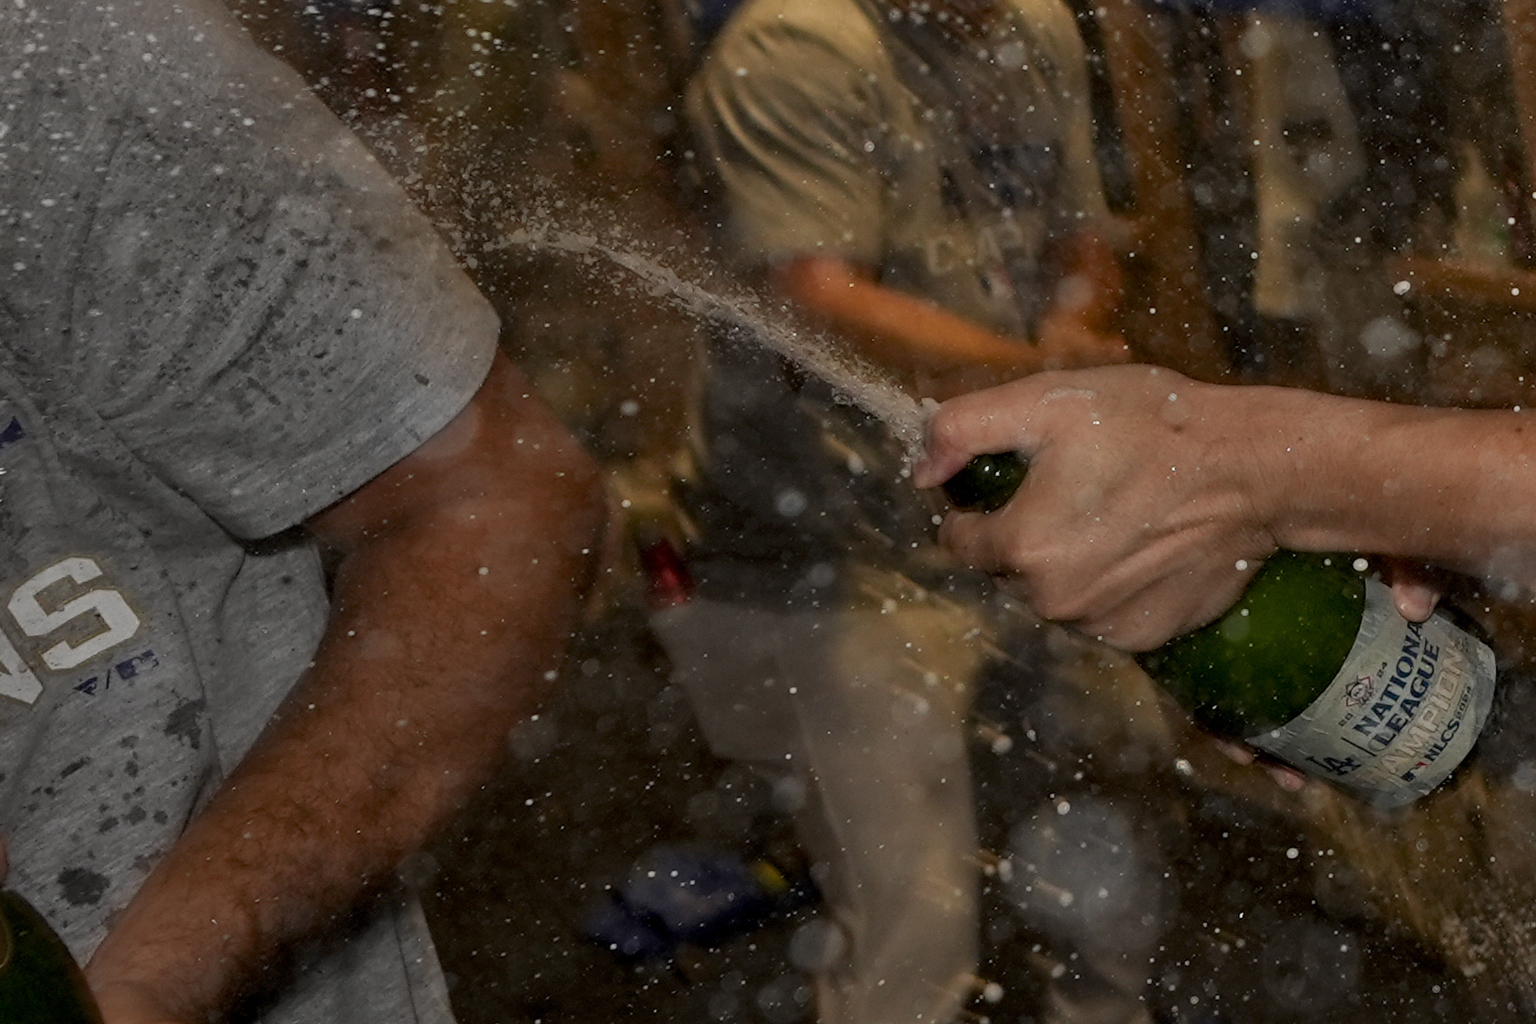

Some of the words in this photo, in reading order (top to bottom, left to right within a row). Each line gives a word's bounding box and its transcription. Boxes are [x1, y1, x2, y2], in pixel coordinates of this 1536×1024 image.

[1352, 620, 1423, 737] NATIONA
[1372, 637, 1441, 747] LEAGUE
[1423, 717, 1461, 763] NLCS
